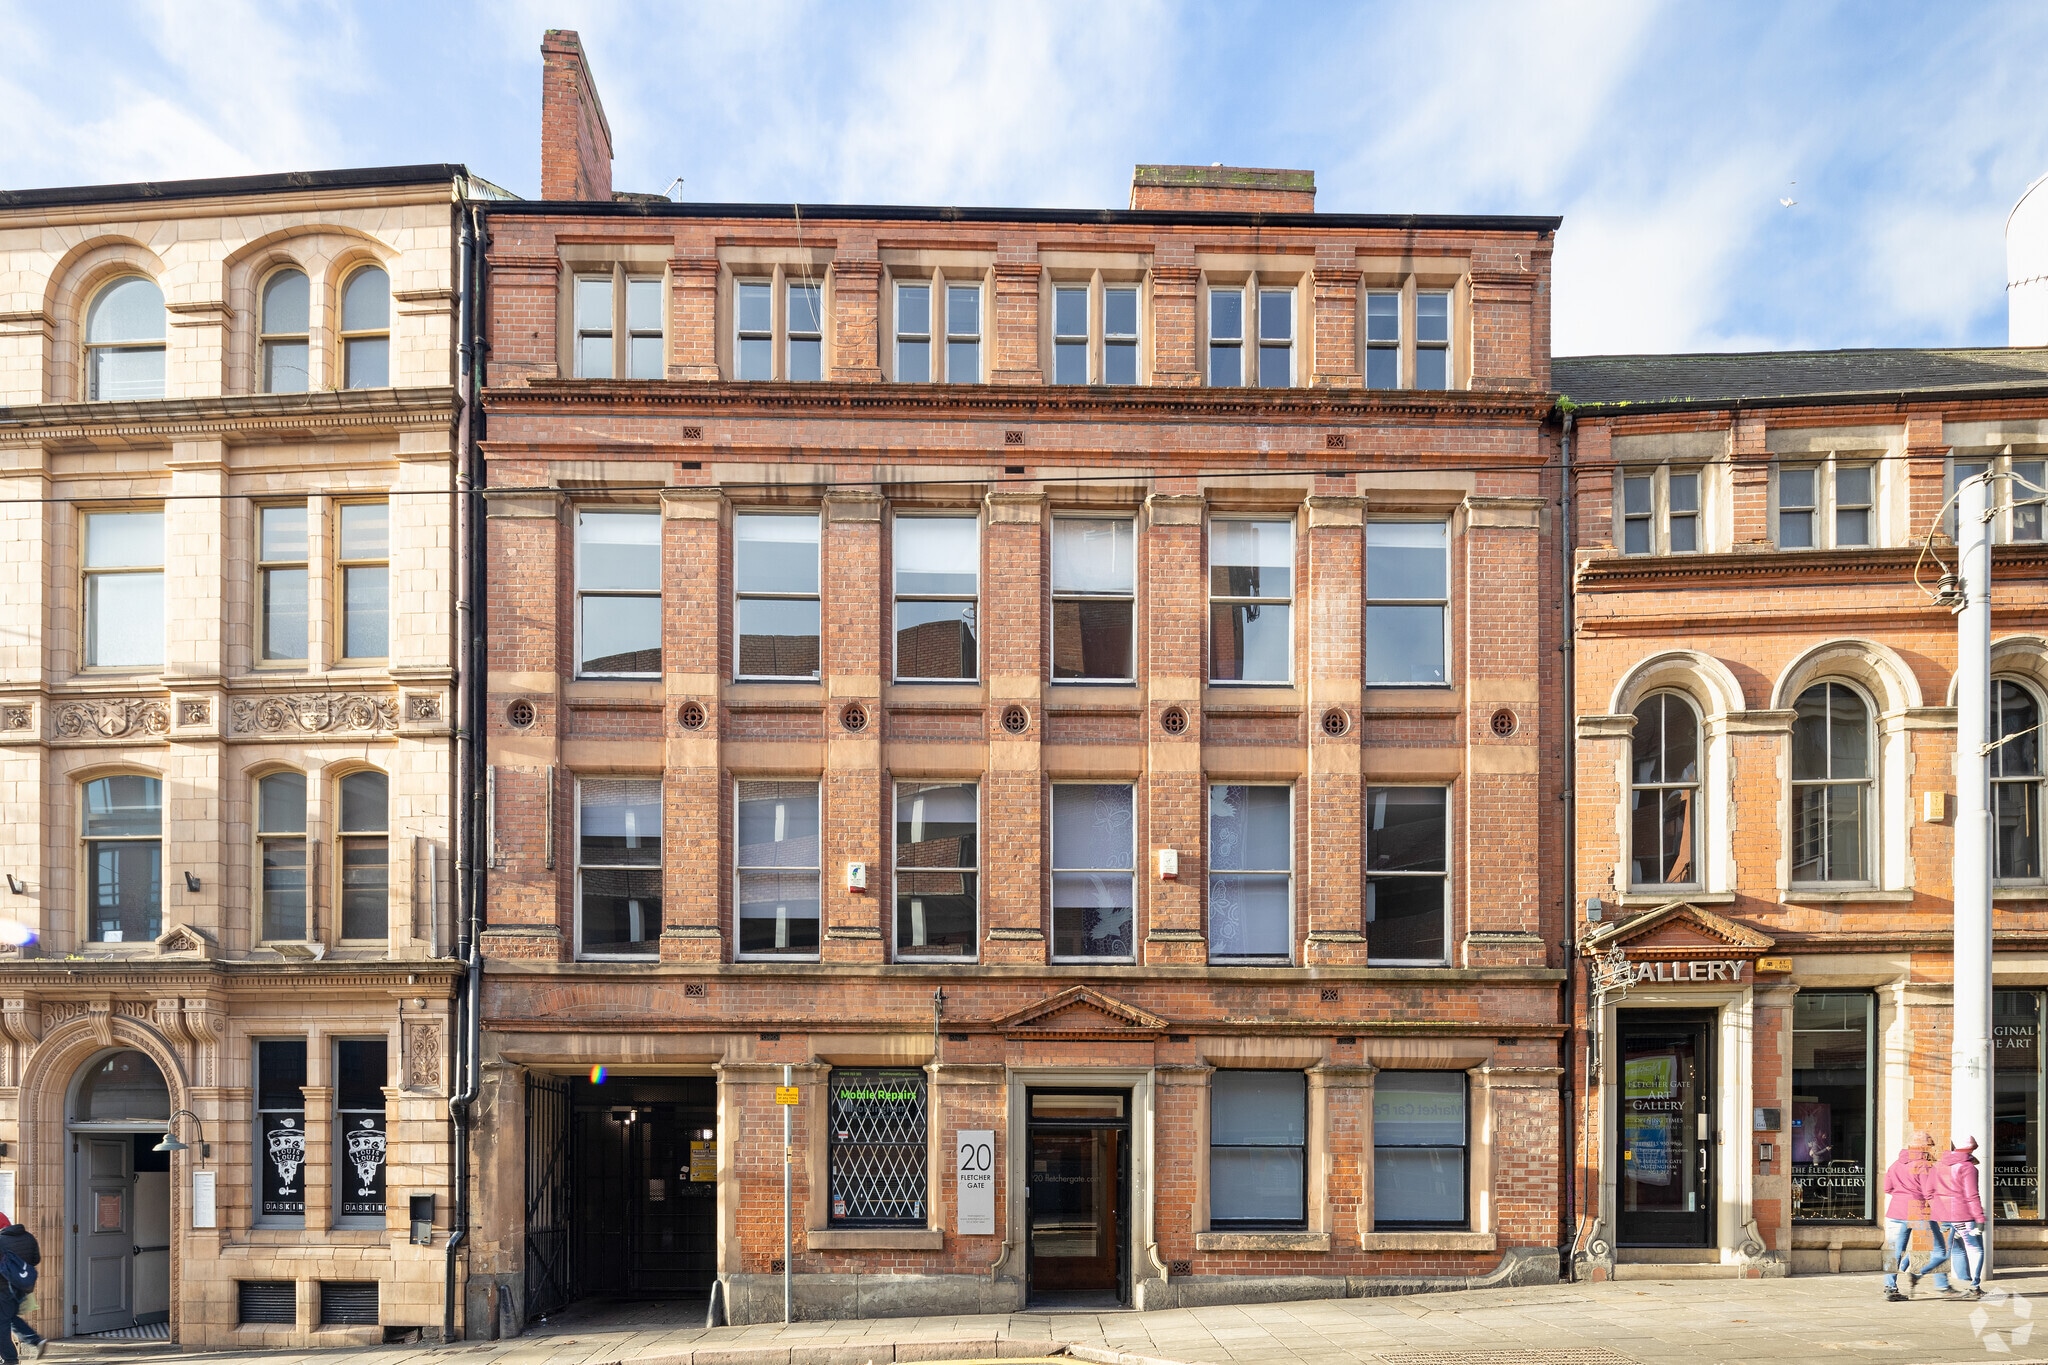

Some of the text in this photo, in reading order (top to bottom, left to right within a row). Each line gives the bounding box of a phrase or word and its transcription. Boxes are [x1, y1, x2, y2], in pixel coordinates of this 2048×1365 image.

[116, 1001, 147, 1019] AND
[1670, 1080, 1691, 1088] GATE
[840, 1090, 917, 1102] Mobile Repairs
[1647, 1090, 1672, 1100] ART
[1632, 1099, 1686, 1111] GALLERY
[276, 1148, 300, 1156] LOUIS
[355, 1148, 380, 1157] LOUIS
[276, 1154, 300, 1163] LOUIS
[355, 1155, 380, 1164] LOUIS
[960, 1143, 992, 1171] 20
[1792, 1166, 1866, 1174] THE FLETCHER GAT
[1792, 1176, 1866, 1187] ART GALLERY
